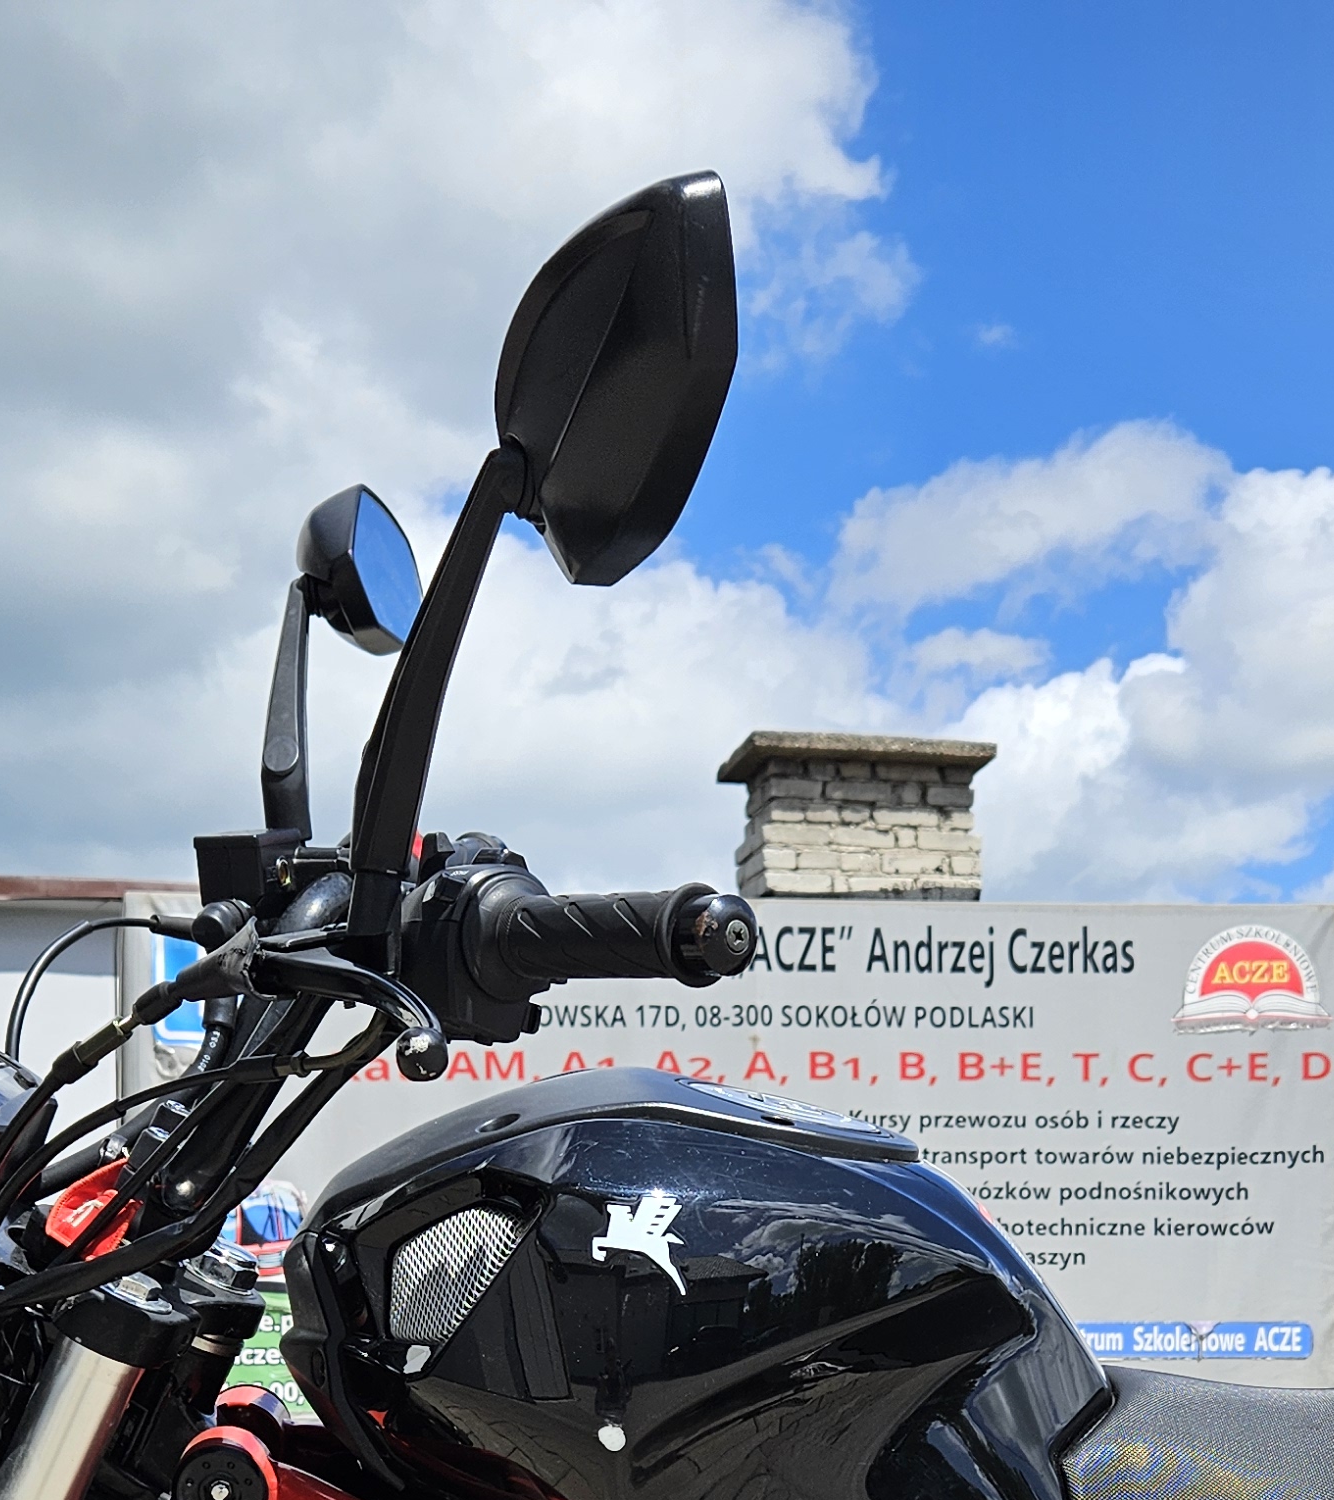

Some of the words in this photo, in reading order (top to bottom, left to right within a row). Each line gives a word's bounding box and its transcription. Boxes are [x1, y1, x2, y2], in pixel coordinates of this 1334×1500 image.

[865, 925, 995, 988] Andrzej
[1007, 926, 1135, 975] Czerkas
[1184, 931, 1234, 995] CENTRUM
[1211, 960, 1290, 985] ACZE
[635, 1004, 687, 1032] 17D,
[694, 1004, 773, 1029] 08-300
[780, 998, 907, 1029] SOKOŁÓW
[914, 1005, 1034, 1029] PODLASKI
[743, 1050, 789, 1087] A,
[809, 1050, 880, 1087] B1,
[899, 1051, 938, 1087] B,
[958, 1051, 1056, 1088] B+E,
[1072, 1052, 1110, 1088] T,
[1127, 1052, 1168, 1088] C,
[1185, 1052, 1281, 1088] C+E,
[1301, 1052, 1332, 1082] D
[919, 1113, 1026, 1133] przewozu
[1034, 1109, 1089, 1129] osób
[1096, 1110, 1103, 1129] i
[1110, 1114, 1180, 1135] rzeczy
[922, 1147, 1027, 1170] transport
[1034, 1145, 1135, 1165] towarów
[1141, 1144, 1326, 1171] niebezpiecznych
[1058, 1180, 1249, 1206] podnośnikowych
[1153, 1216, 1275, 1237] kierowców
[1253, 1326, 1303, 1352] ACZE
